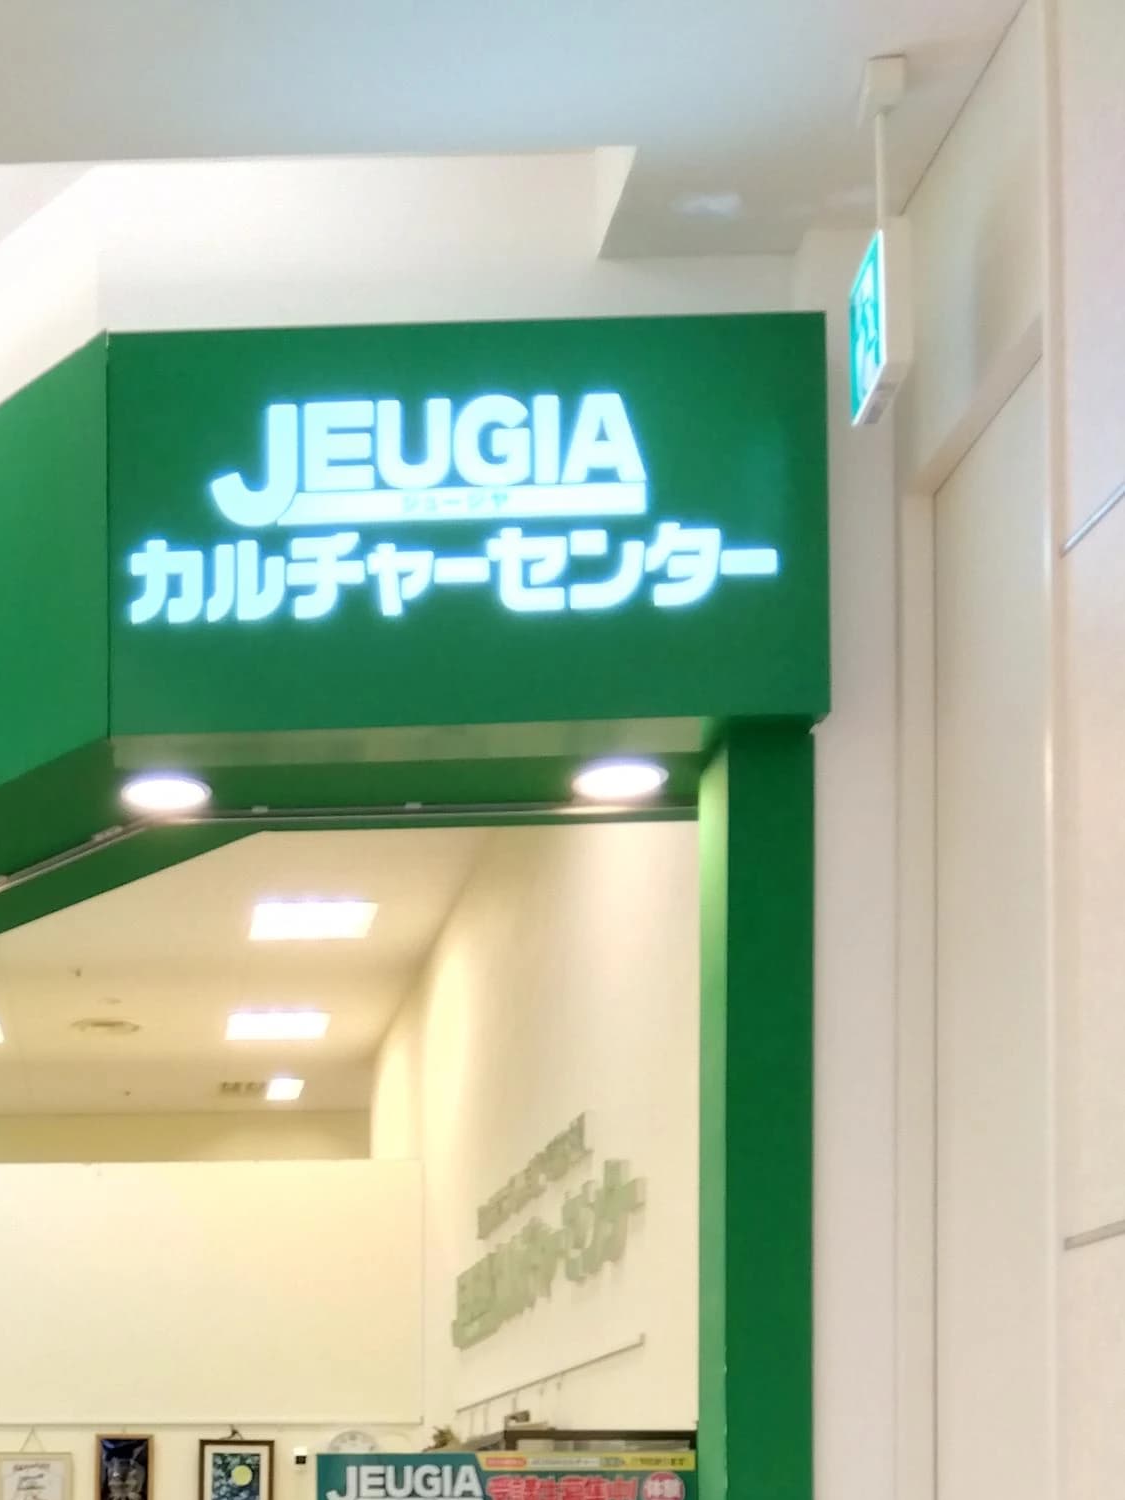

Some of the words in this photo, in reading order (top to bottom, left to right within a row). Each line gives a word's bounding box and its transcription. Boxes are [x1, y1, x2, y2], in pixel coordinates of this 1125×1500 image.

[211, 393, 647, 526] JEUGIA
[129, 522, 779, 625] カルチャーセンター
